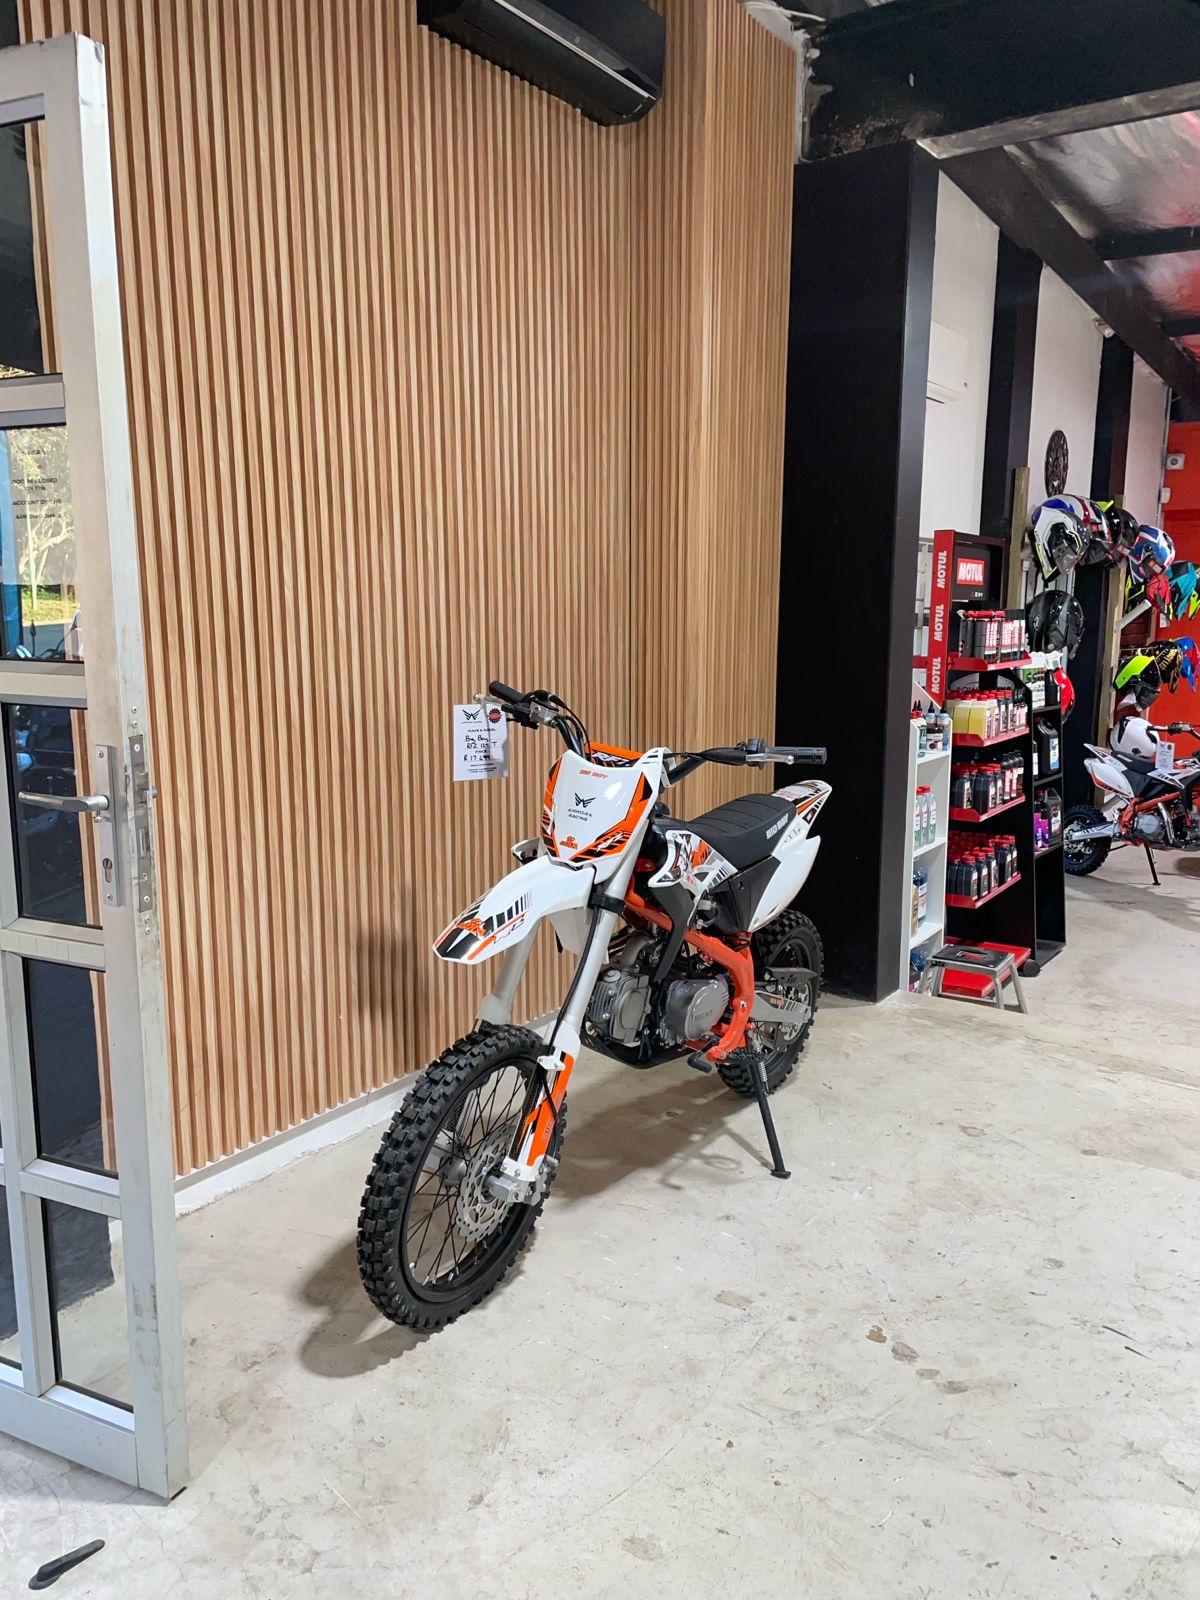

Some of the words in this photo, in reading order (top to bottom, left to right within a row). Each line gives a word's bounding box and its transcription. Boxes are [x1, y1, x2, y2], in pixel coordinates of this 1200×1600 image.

[937, 550, 947, 589] MOTUL
[958, 562, 984, 582] MOTUL
[934, 603, 944, 642] MOTUL
[931, 657, 942, 694] MOTUL
